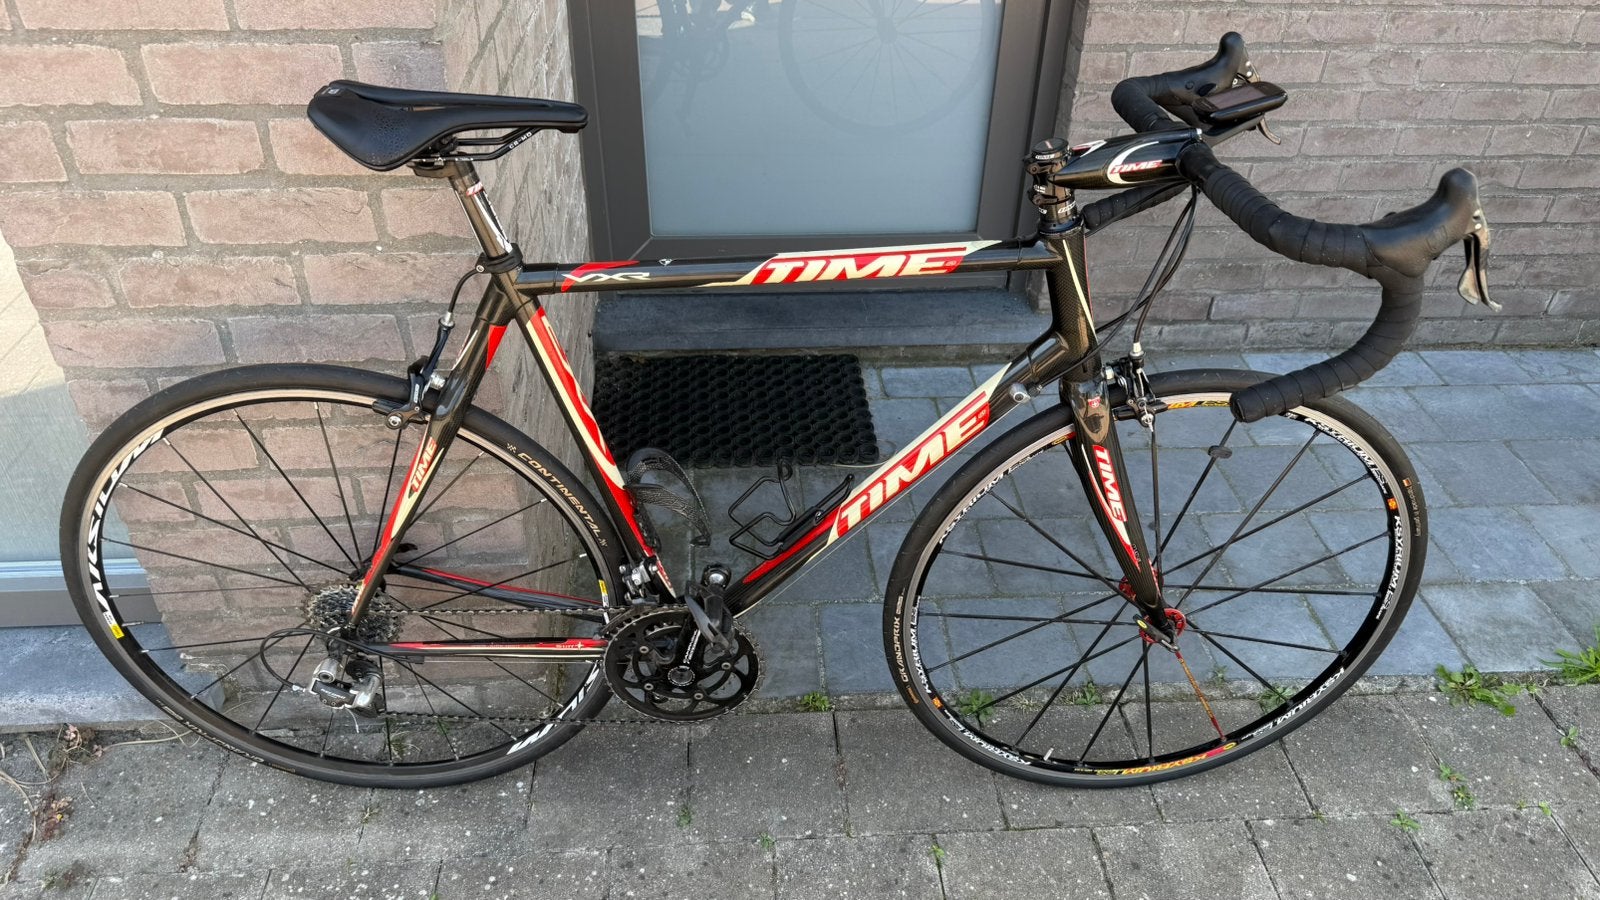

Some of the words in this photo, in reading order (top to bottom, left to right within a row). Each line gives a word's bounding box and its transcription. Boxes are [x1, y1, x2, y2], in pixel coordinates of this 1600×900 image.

[1110, 160, 1162, 174] TIME
[562, 271, 650, 284] VXR
[759, 254, 957, 284] TIME
[411, 436, 438, 492] TIME
[841, 399, 986, 531] TIME
[1096, 448, 1127, 522] TIME
[518, 452, 601, 538] CONTINENTAL
